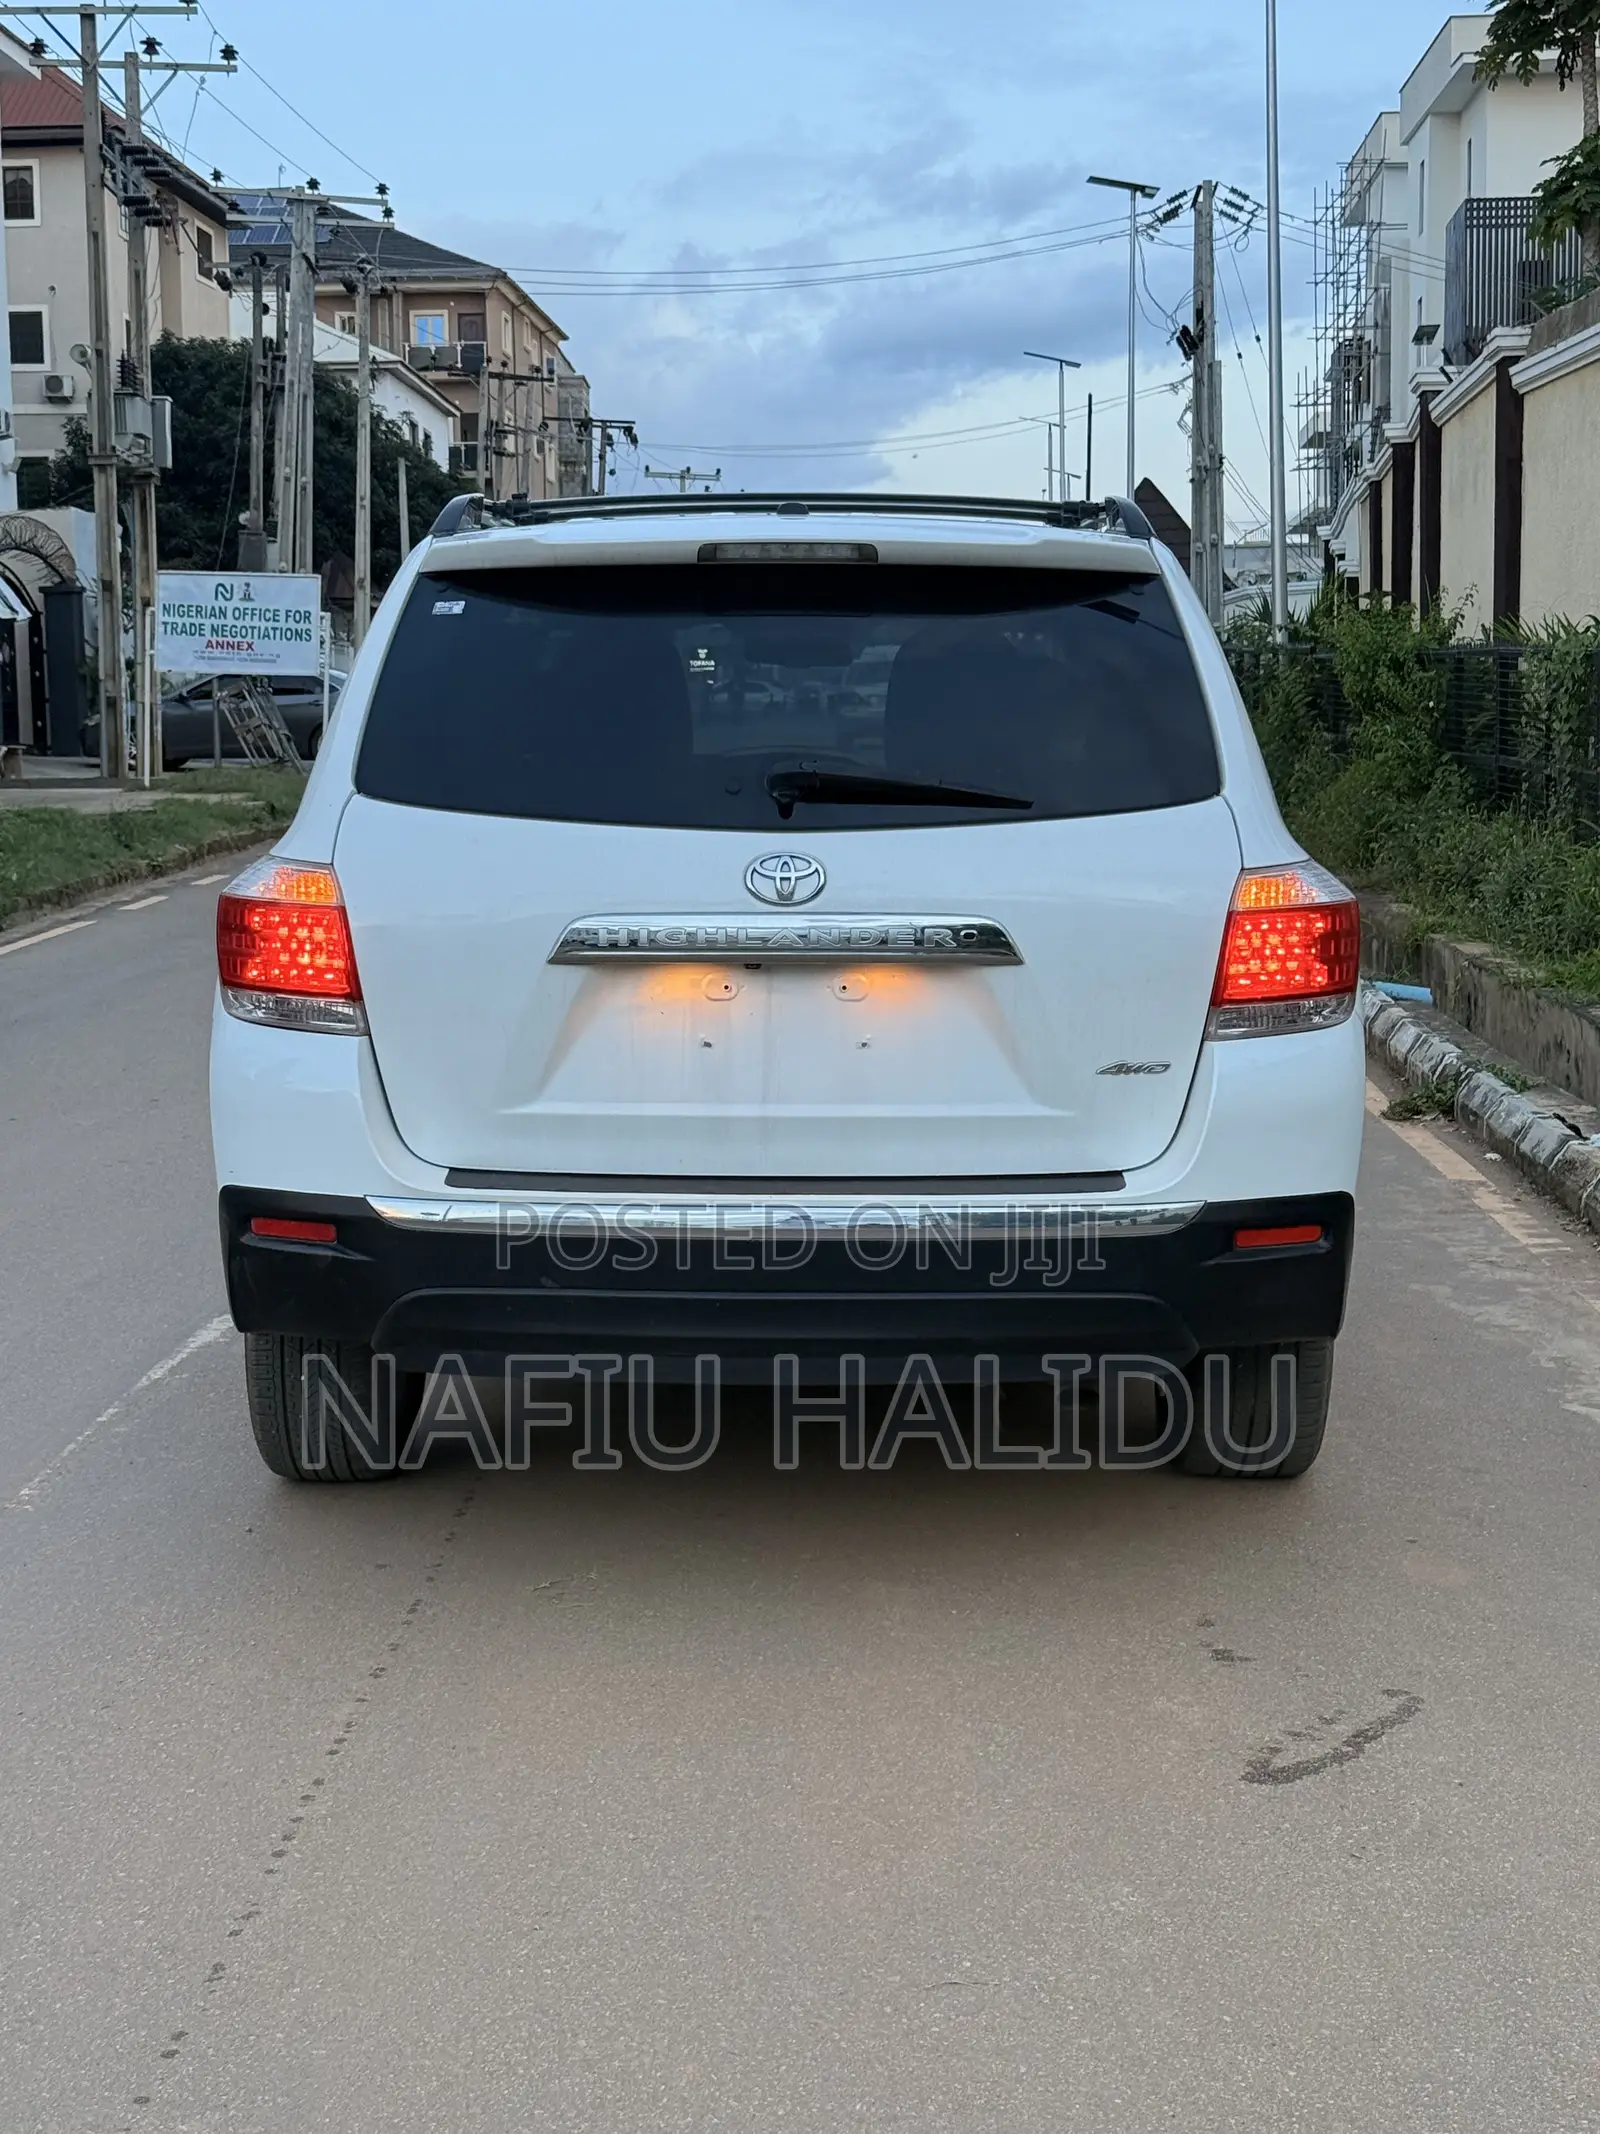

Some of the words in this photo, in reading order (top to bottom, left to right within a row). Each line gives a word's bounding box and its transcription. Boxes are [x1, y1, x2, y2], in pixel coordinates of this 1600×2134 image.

[162, 603, 228, 620] NIGERIAN
[232, 606, 281, 623] OFFICE
[285, 609, 312, 625] FOR
[161, 621, 206, 637] TRADE
[210, 623, 312, 643] NEGOTIATIONS
[205, 639, 255, 652] ANNEX
[597, 927, 957, 947] HIGHLANDER
[1096, 1060, 1171, 1075] 4WD
